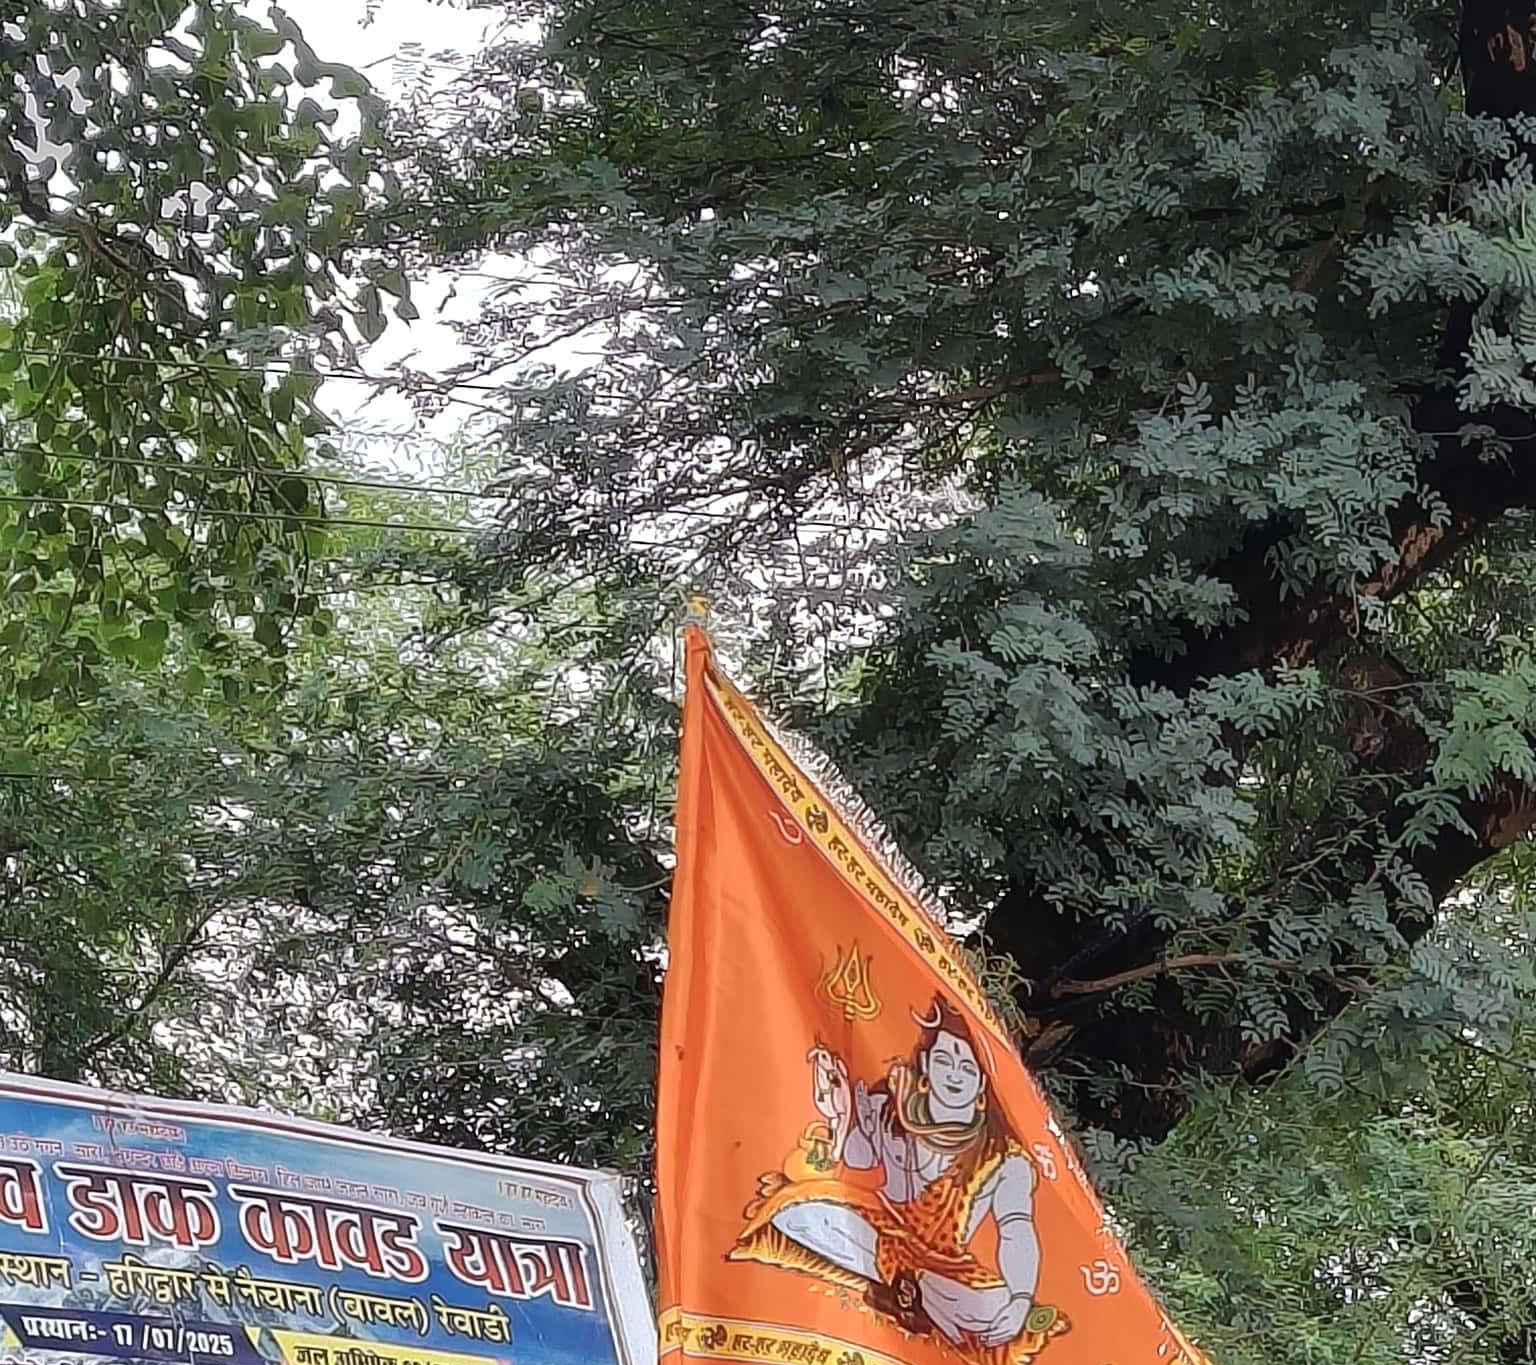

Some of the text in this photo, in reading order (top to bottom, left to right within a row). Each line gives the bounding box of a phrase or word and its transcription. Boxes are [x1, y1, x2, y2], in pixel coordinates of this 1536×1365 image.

[56, 1163, 219, 1248] डाक
[232, 1188, 427, 1277] कावड
[438, 1222, 592, 1307] यात्रा
[104, 1256, 196, 1302] हरिद्वार
[201, 1264, 230, 1305] से
[234, 1267, 324, 1314] नैचाना
[329, 1287, 428, 1336] (बावल)
